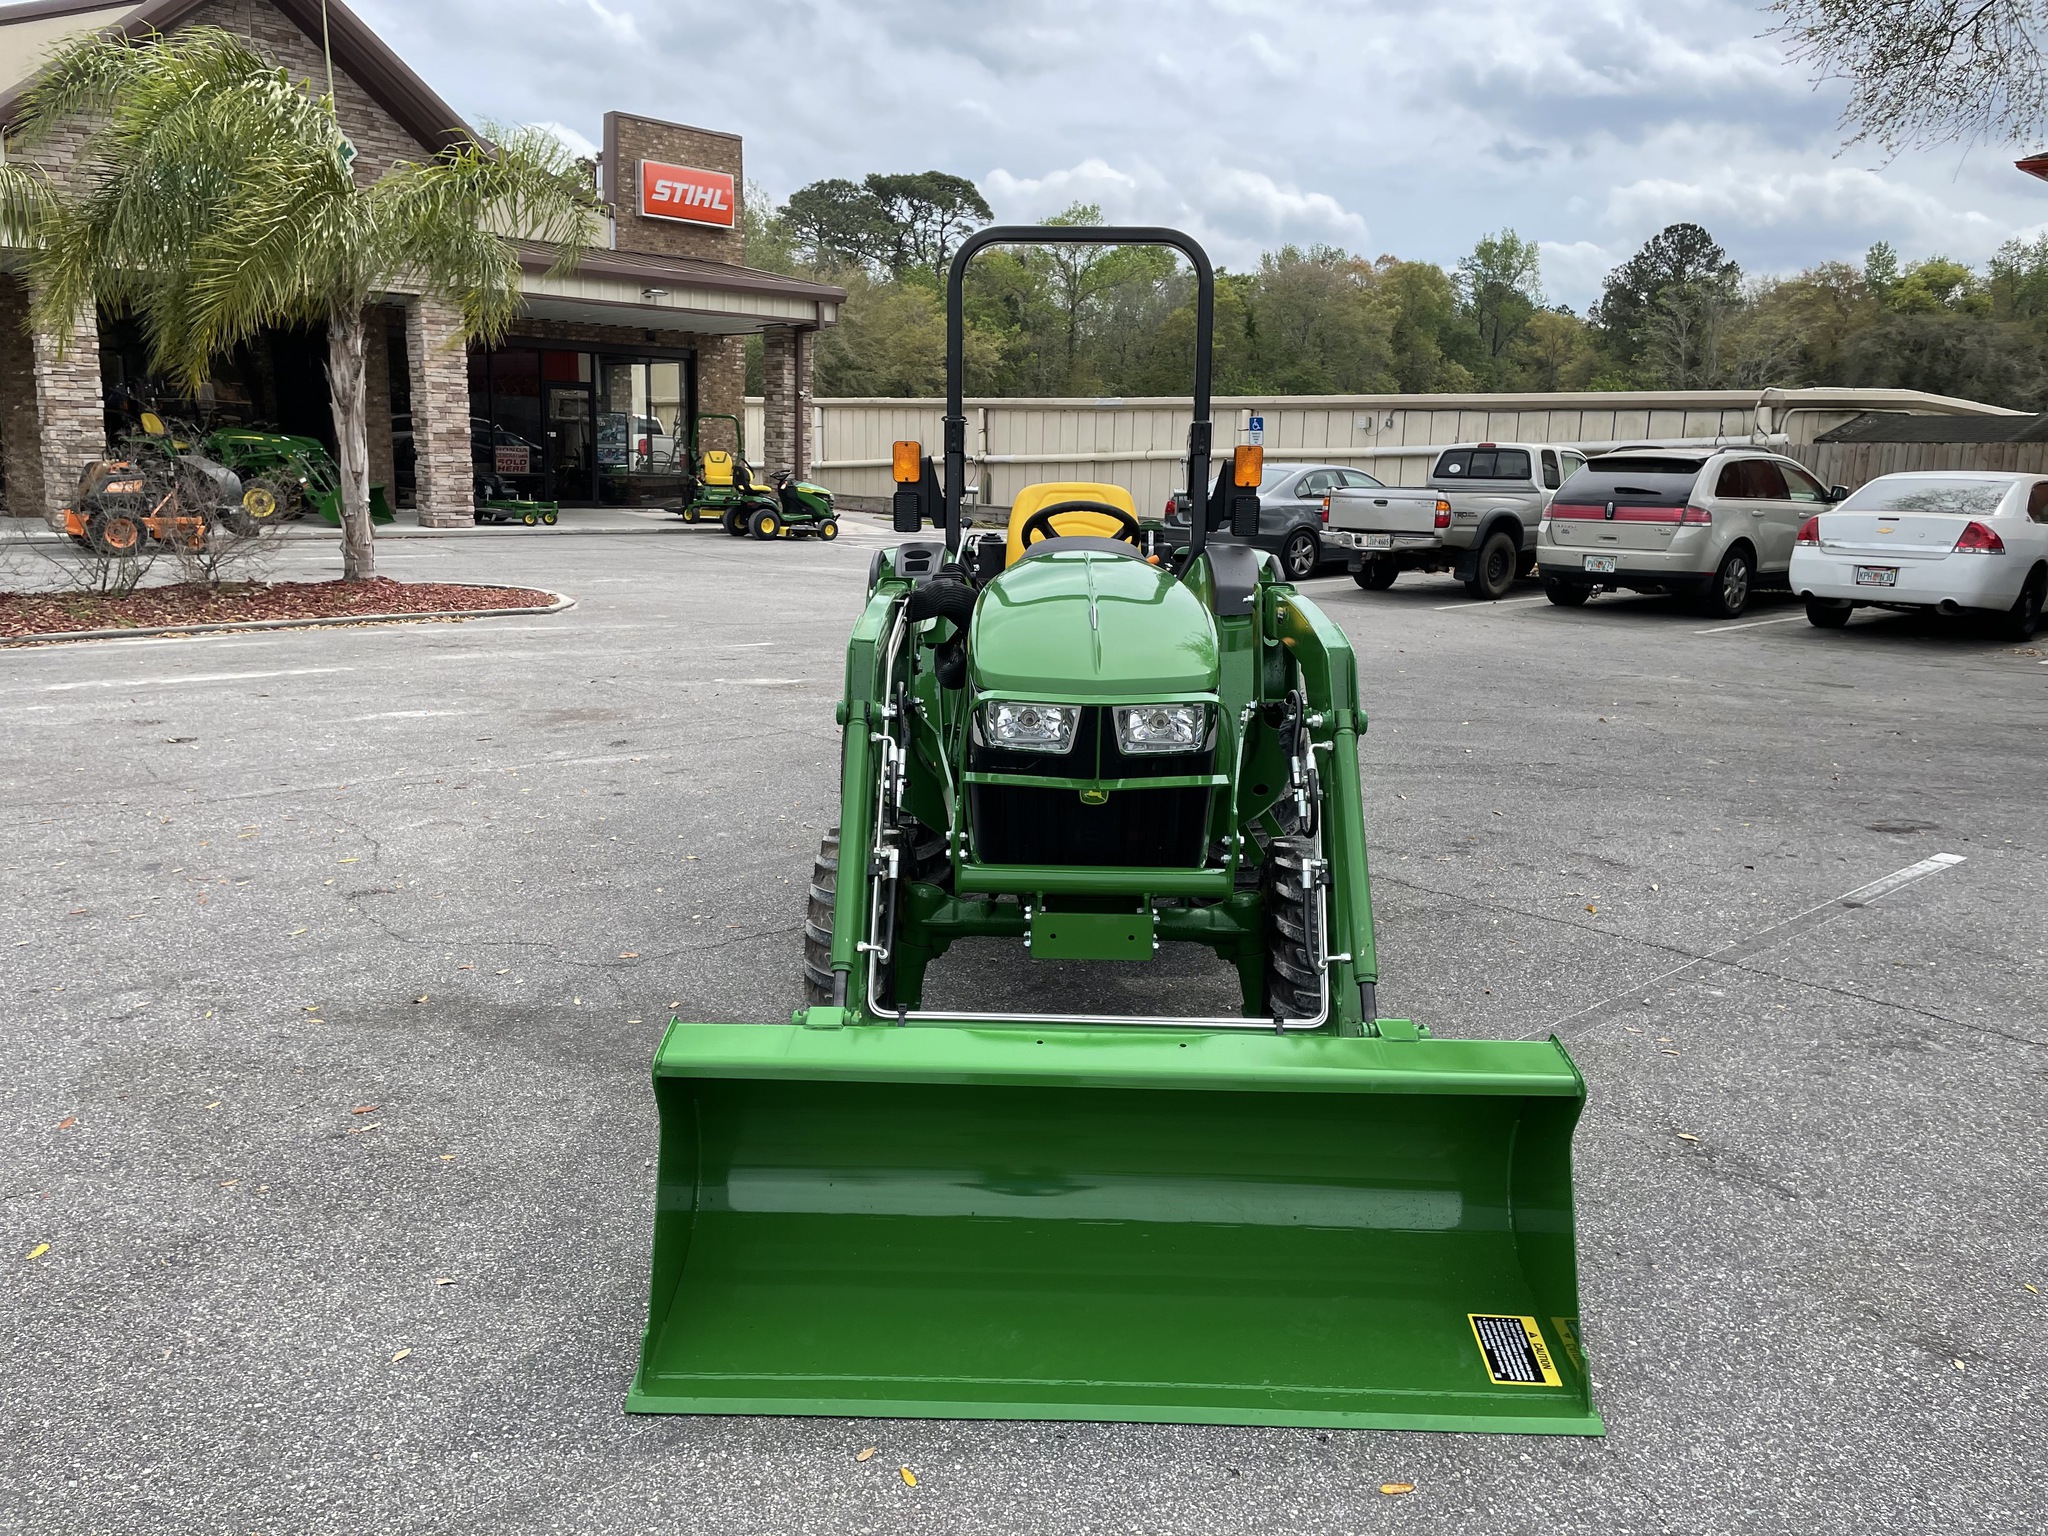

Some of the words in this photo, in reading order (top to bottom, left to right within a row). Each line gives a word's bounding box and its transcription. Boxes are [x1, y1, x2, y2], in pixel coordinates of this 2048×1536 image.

[651, 178, 729, 211] STIHL
[1453, 511, 1468, 519] TRD
[1533, 1342, 1552, 1370] CAUTION
